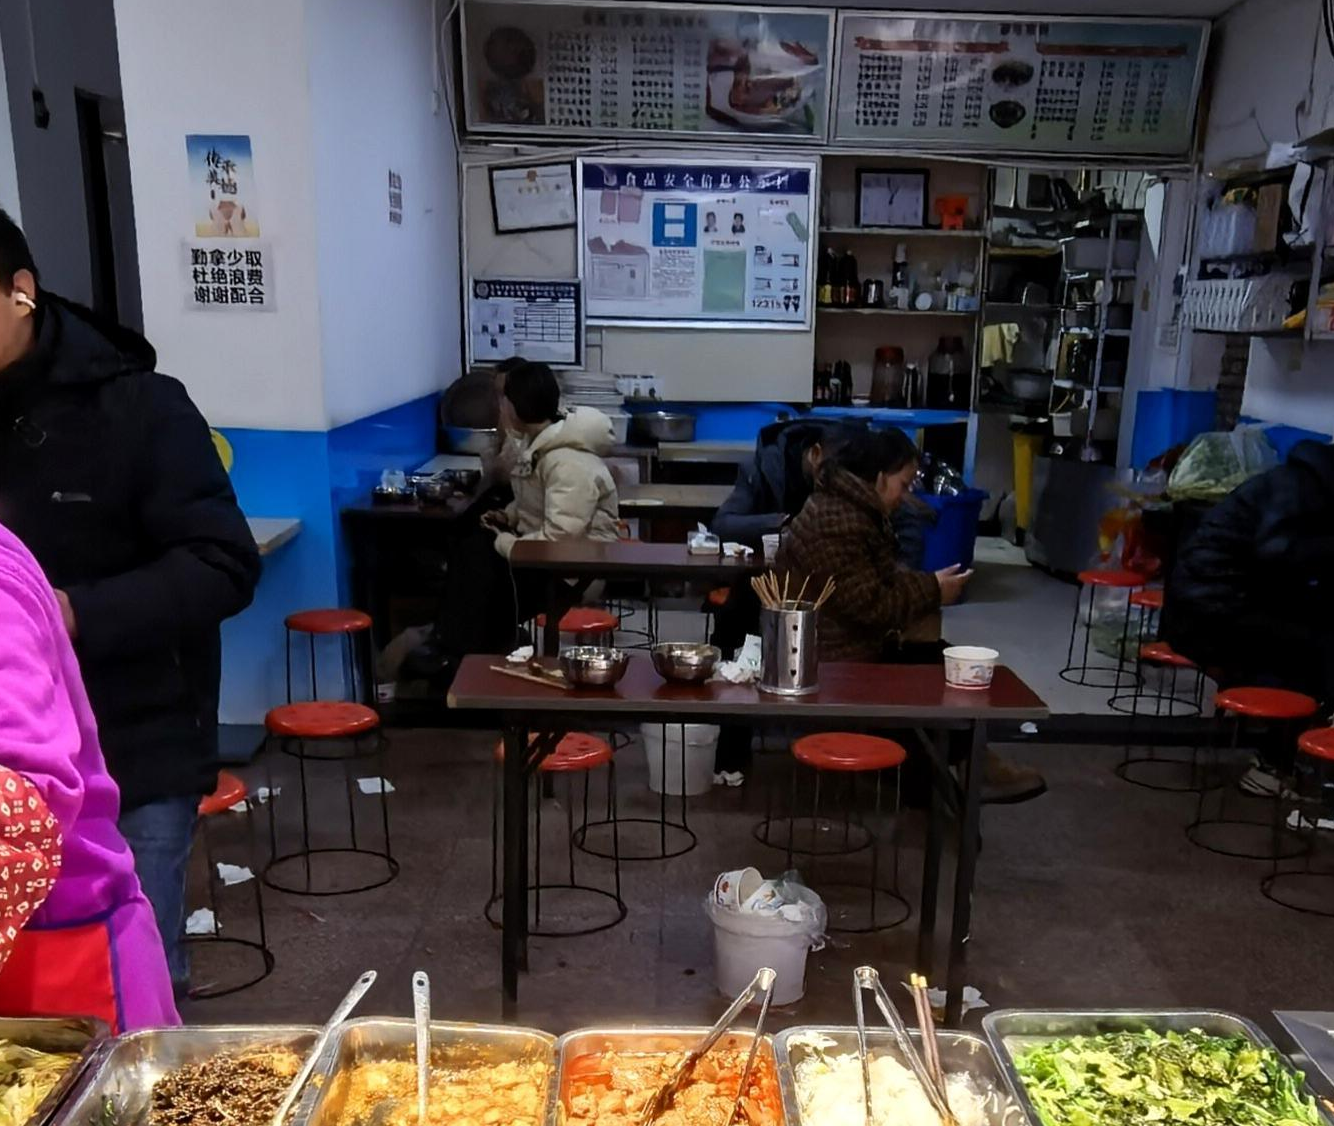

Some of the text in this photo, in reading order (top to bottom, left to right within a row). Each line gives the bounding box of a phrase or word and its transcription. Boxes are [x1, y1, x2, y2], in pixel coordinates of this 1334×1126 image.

[191, 248, 263, 267] 勤拿少取
[192, 267, 264, 286] 杜绝浪费
[194, 285, 265, 305] 谢谢配合
